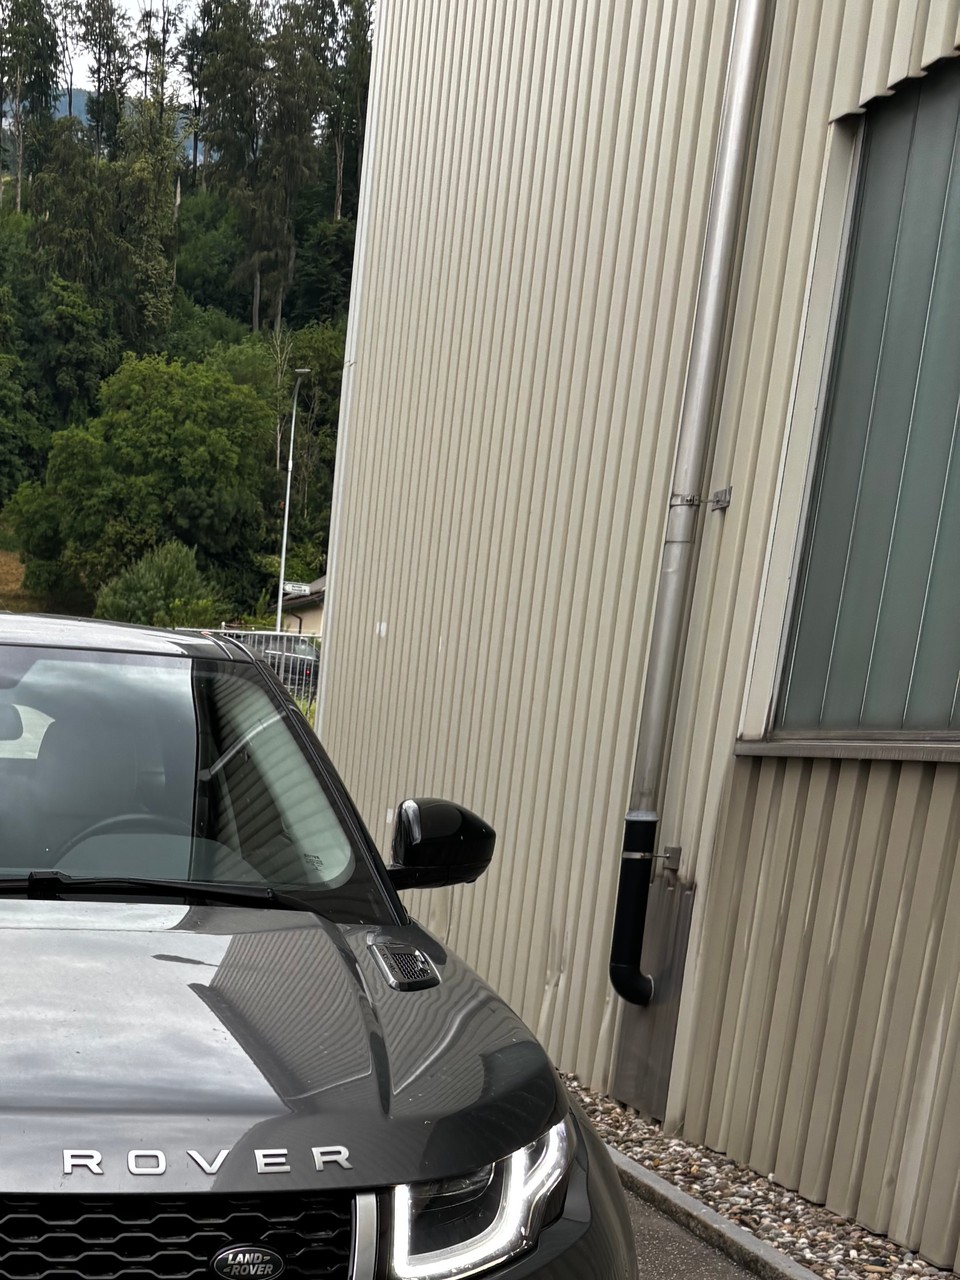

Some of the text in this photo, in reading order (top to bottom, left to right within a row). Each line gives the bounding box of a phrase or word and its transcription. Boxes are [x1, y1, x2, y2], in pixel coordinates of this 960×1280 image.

[62, 1145, 353, 1175] ROVER
[227, 1253, 263, 1264] LAND
[230, 1264, 274, 1275] ROVER
